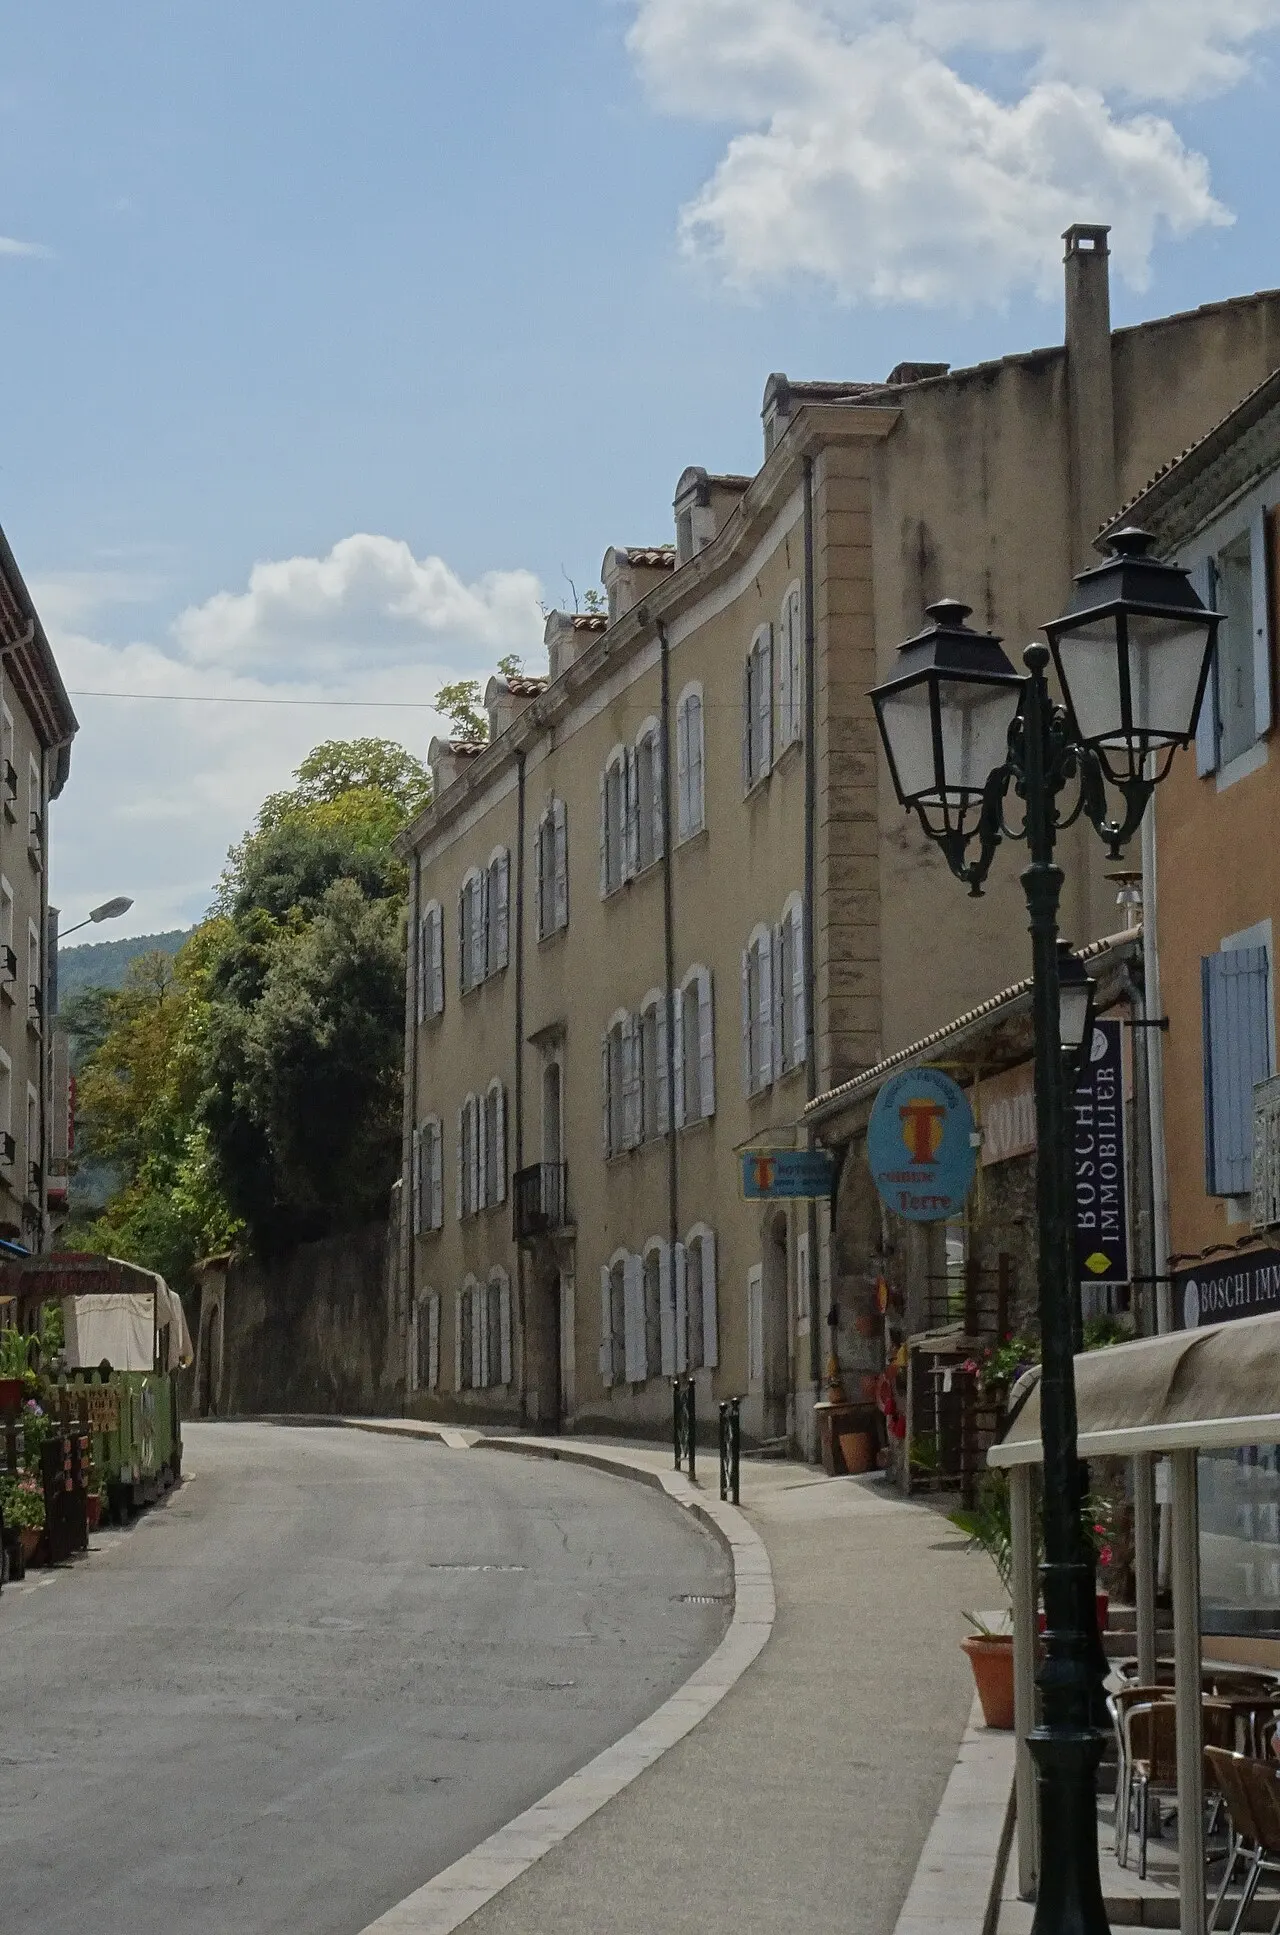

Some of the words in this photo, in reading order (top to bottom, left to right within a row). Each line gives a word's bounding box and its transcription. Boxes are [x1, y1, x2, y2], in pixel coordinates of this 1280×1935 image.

[1097, 1067, 1119, 1242] IMMOBILIER
[895, 1191, 952, 1211] Terre
[1200, 1273, 1251, 1313] BOSCHI
